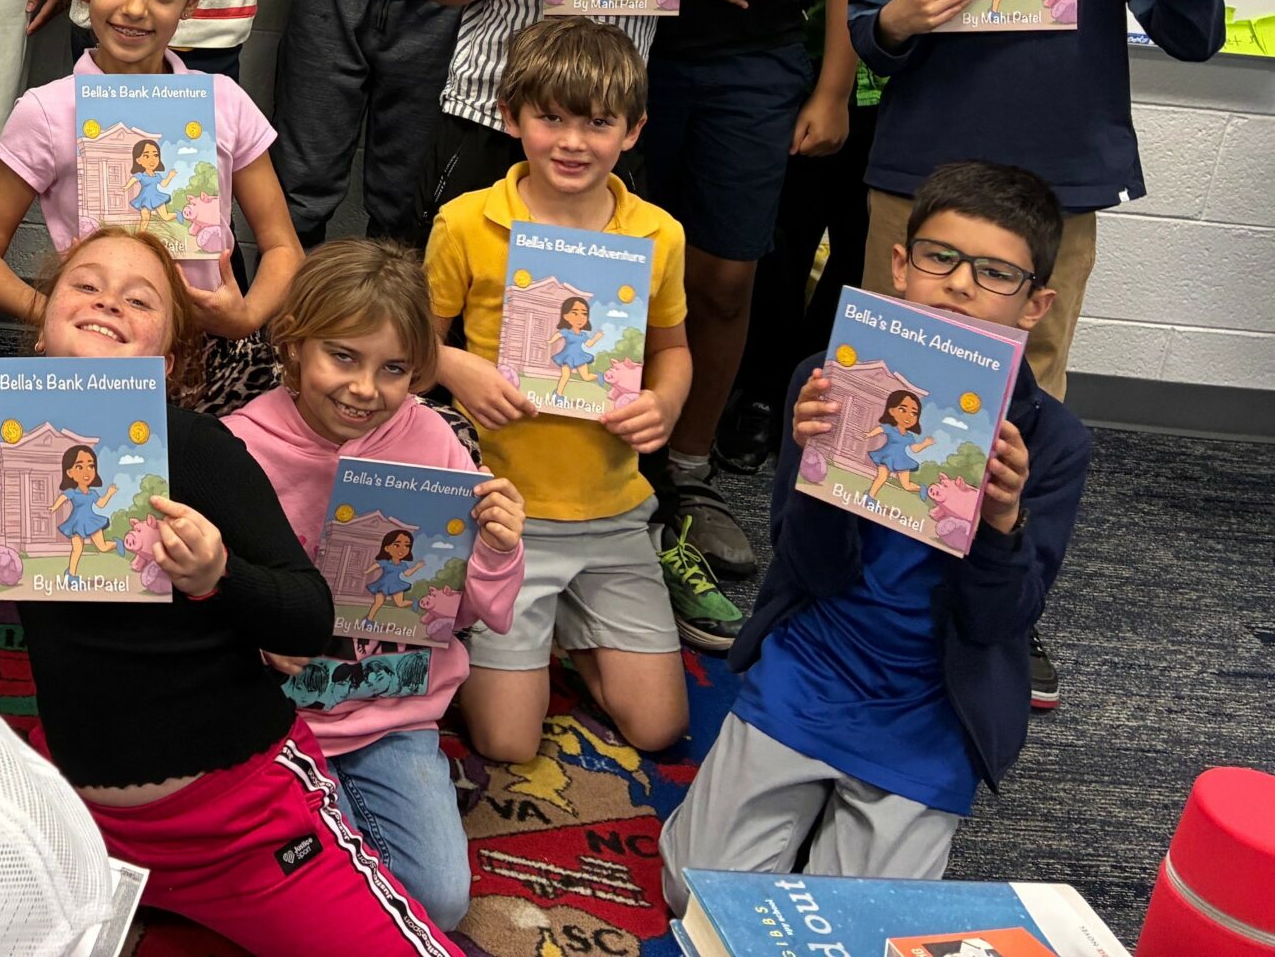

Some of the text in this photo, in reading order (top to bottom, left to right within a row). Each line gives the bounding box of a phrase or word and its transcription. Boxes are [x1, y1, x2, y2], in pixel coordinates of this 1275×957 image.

[1013, 12, 1041, 23] Patel
[82, 86, 207, 98] Bella's Bank Adventure
[516, 234, 646, 263] Bella's Bank Adventure
[845, 304, 1000, 371] Bella's Bank Adventure
[0, 374, 157, 391] Bella's Bank Adventure
[576, 398, 605, 414] Patel
[343, 471, 418, 491] Bella's Bank
[832, 483, 925, 532] By Mahi Patel
[33, 575, 129, 595] By Mahi Patel
[335, 617, 417, 637] By Mahi Patel
[484, 796, 551, 824] VA
[294, 838, 313, 853] Justice
[584, 829, 660, 858] NC
[775, 880, 832, 934] out
[566, 924, 630, 956] SC
